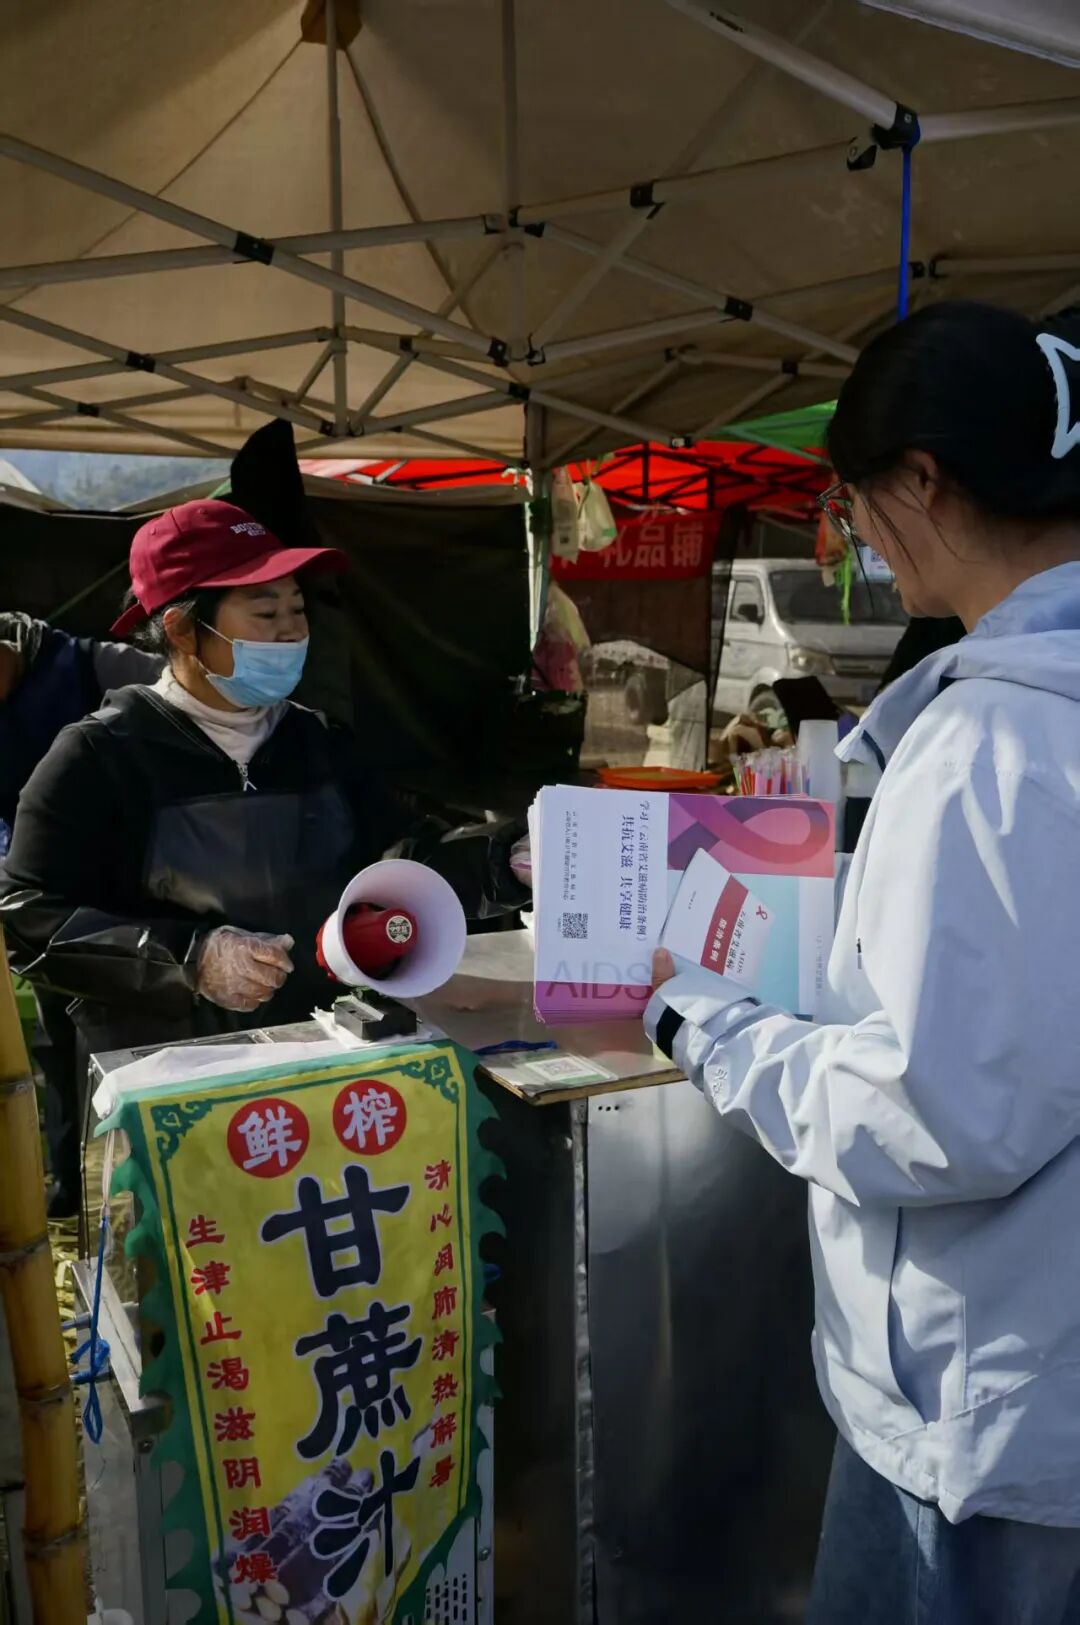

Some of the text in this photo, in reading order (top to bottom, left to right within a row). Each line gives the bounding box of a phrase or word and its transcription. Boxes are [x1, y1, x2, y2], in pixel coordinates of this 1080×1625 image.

[545, 959, 654, 1000] AIDS
[619, 815, 635, 930] 共抗艾滋 共享健康
[185, 1214, 279, 1585] 生津止渴滋阴润燥
[261, 1164, 423, 1600] 甘蔗汁
